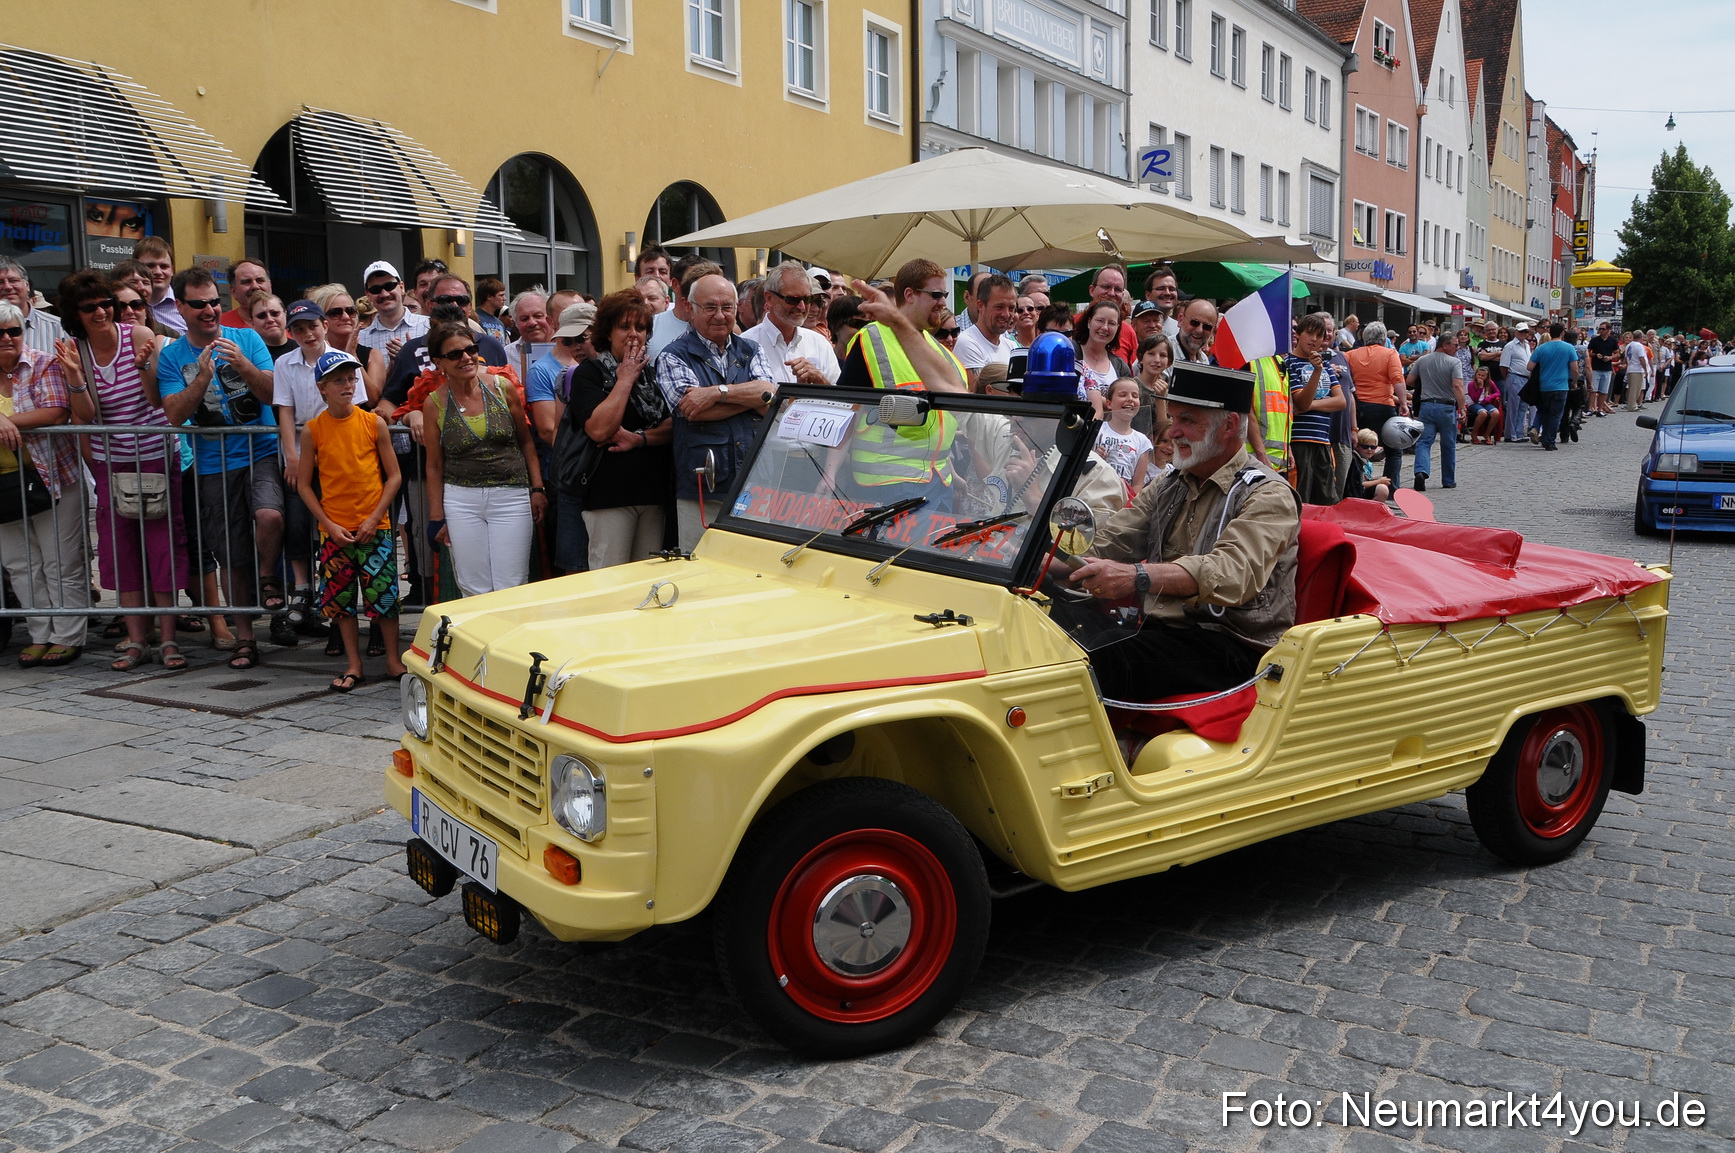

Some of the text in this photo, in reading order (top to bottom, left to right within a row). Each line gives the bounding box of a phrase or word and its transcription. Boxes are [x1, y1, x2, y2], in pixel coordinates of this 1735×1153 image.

[997, 0, 1075, 54] BRILLEN WEBER
[100, 243, 135, 255] Passbild
[1574, 221, 1588, 269] HOT
[806, 416, 835, 439] 130
[422, 801, 489, 880] R CV 76
